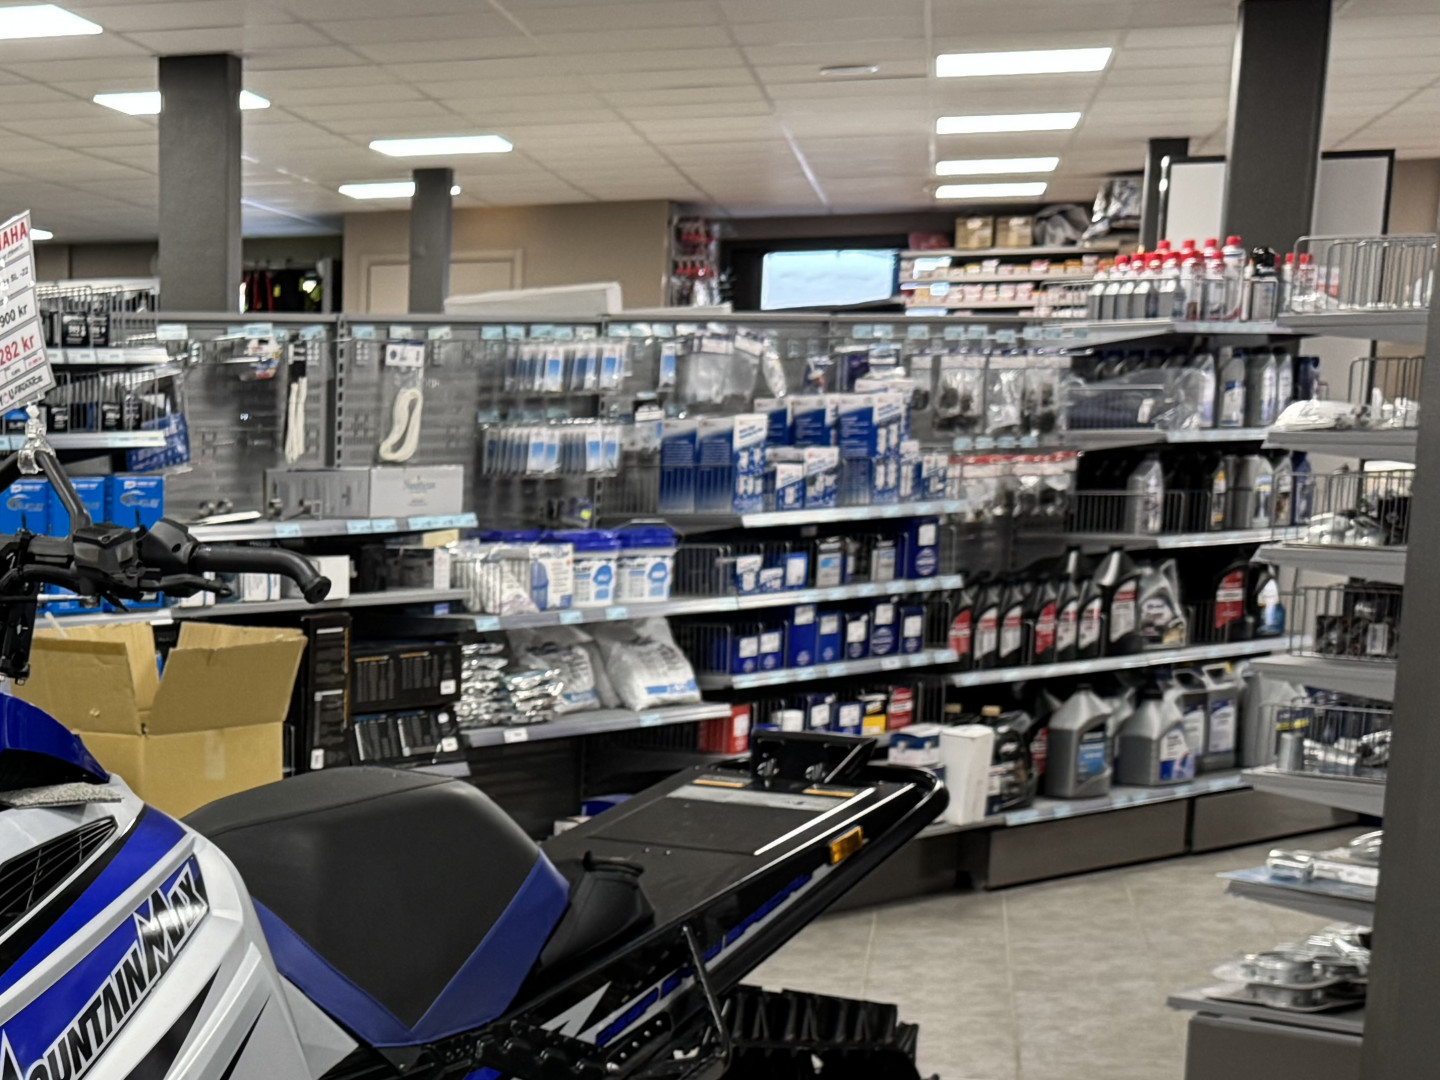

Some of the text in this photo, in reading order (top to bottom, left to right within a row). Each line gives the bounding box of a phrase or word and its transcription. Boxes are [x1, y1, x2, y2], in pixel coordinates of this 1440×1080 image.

[0, 309, 16, 328] 900
[18, 305, 28, 316] kr
[21, 335, 34, 353] kr
[132, 861, 209, 984] MAX
